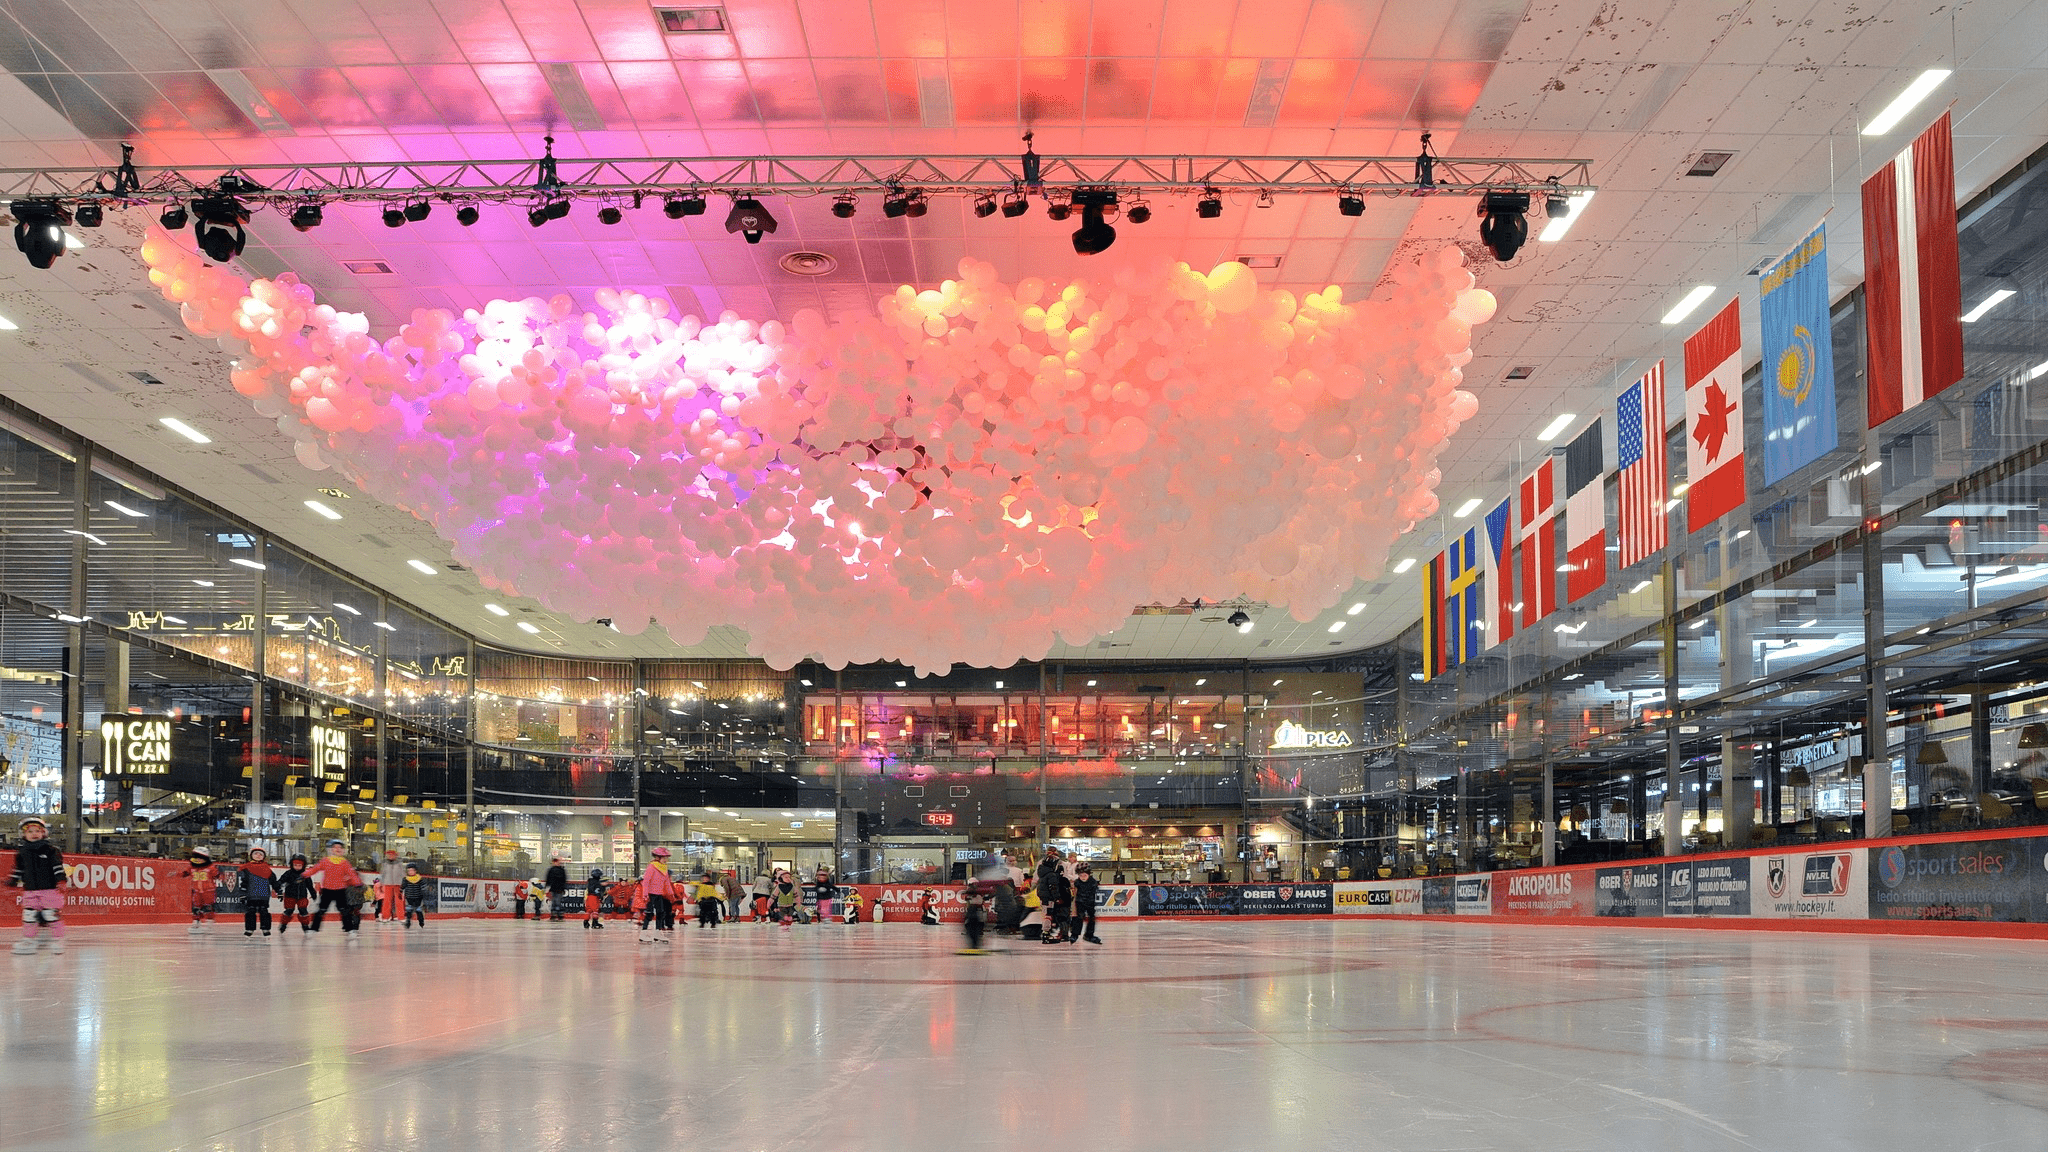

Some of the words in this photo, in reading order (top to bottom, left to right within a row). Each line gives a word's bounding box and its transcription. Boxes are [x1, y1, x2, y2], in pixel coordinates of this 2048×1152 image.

[128, 721, 171, 741] CAN
[325, 727, 346, 750] CAN
[1306, 733, 1349, 745] PICA
[128, 742, 171, 761] CAN
[325, 747, 346, 770] CAN
[130, 764, 166, 774] PIZZA
[929, 814, 953, 825] 9:43
[1907, 851, 2003, 882] sportsales
[1508, 872, 1572, 896] AKROPOLIS
[1599, 875, 1621, 889] OBER
[1633, 873, 1658, 888] HAUS
[1670, 868, 1690, 887] ICE
[1806, 872, 1830, 881] NVLRL
[563, 888, 586, 898] OBE
[1243, 890, 1276, 899] OBER
[1295, 889, 1327, 899] HAUS
[1394, 888, 1421, 903] CCM
[67, 895, 76, 906] IR
[78, 895, 121, 909] PRAMOGŲ
[122, 894, 156, 906] SOSTINĖ
